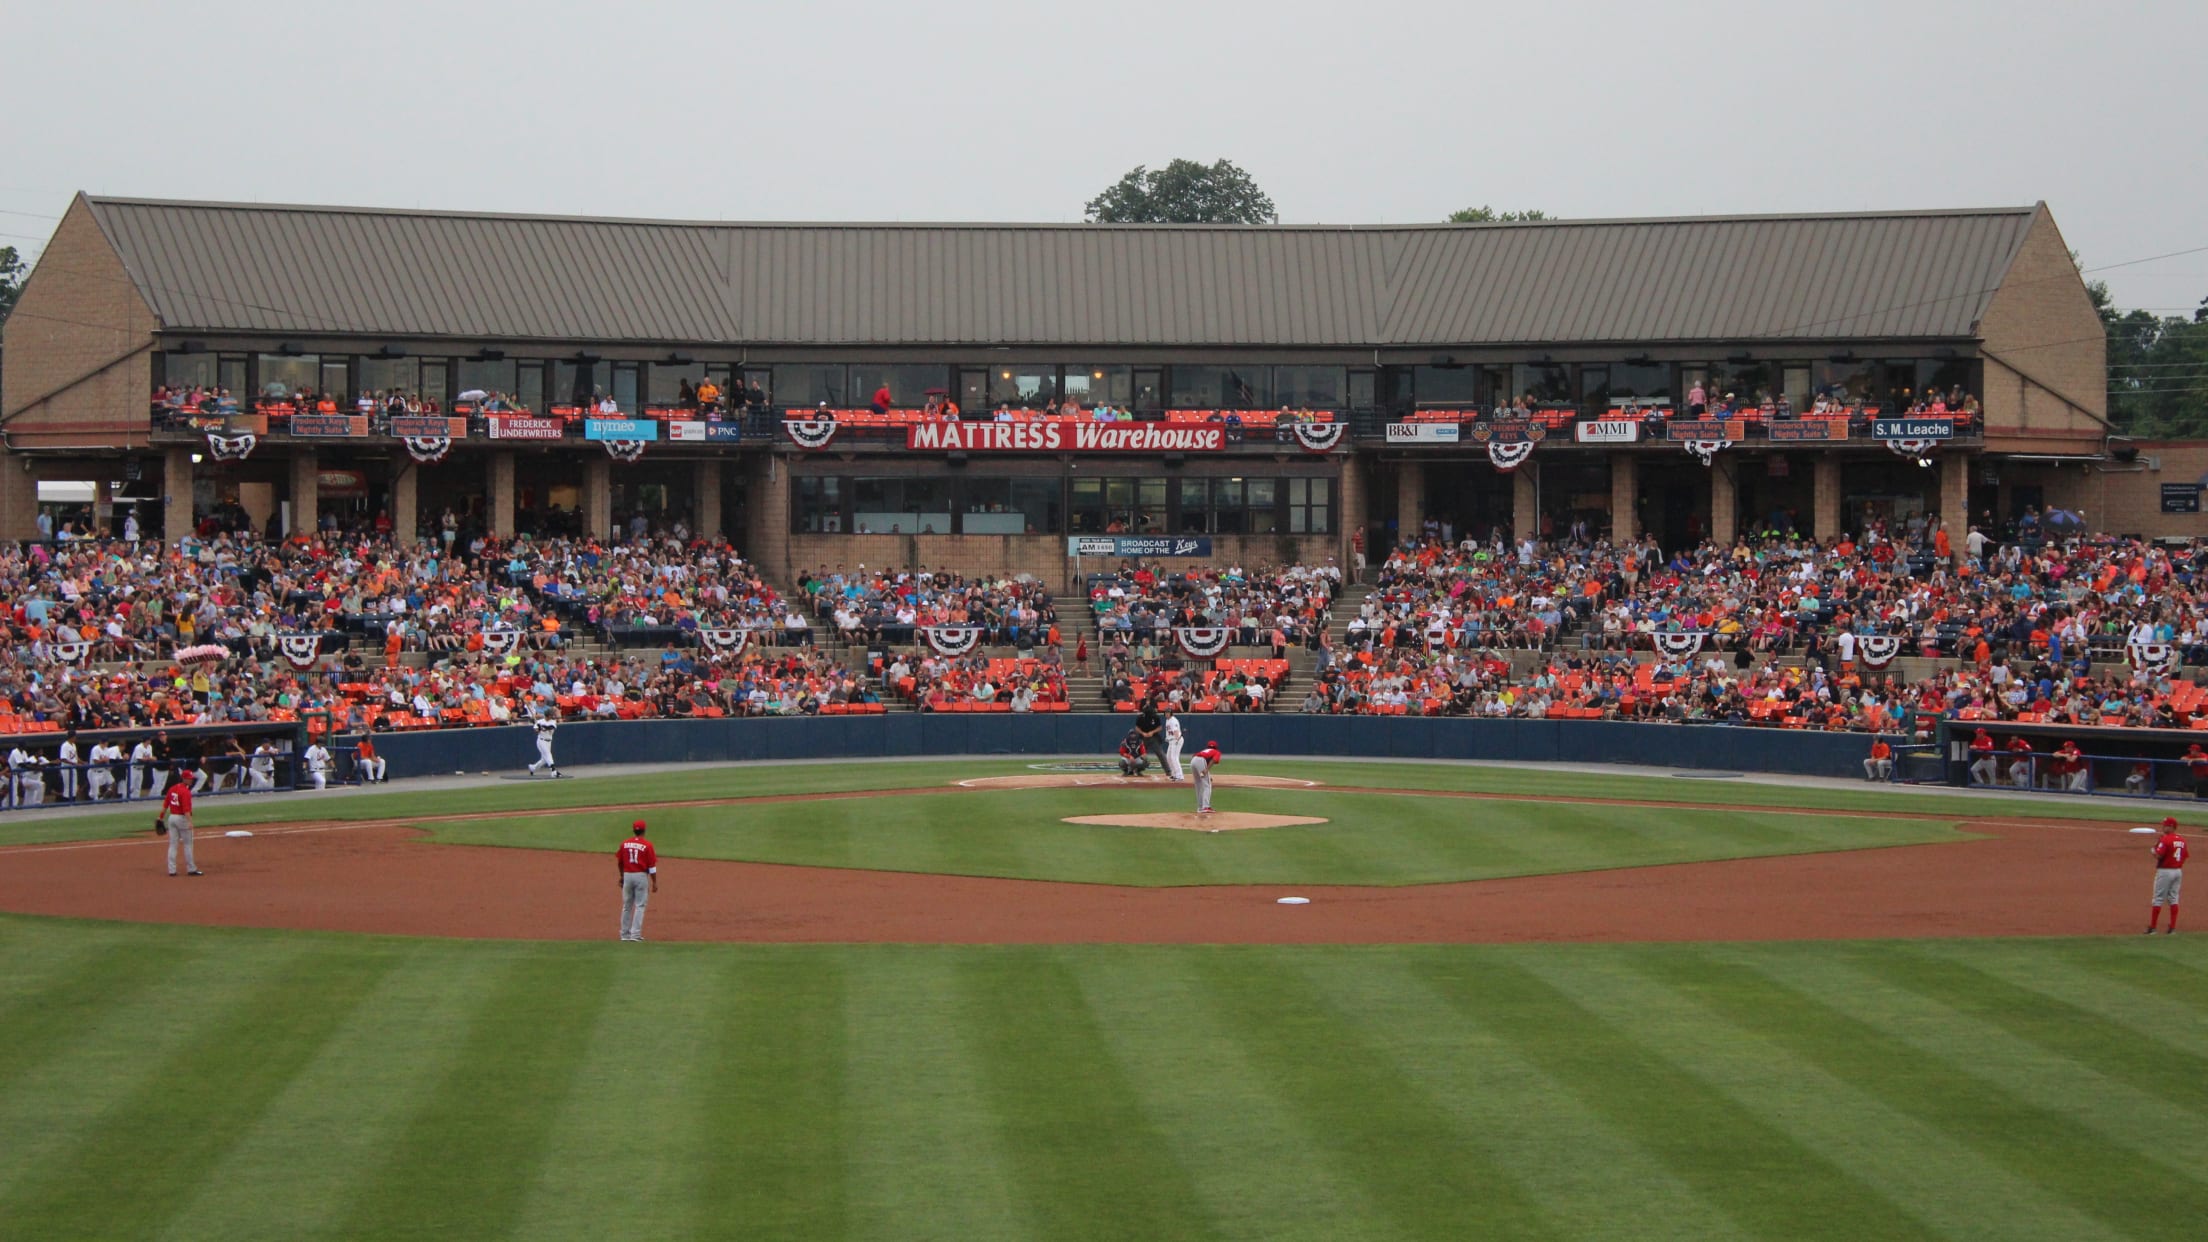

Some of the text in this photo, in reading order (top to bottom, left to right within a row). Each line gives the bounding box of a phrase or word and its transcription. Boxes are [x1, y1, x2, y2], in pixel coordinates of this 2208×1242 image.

[509, 420, 552, 428] FREDERICK
[592, 421, 636, 435] nymeo
[1597, 423, 1628, 434] MMI
[1876, 423, 1949, 435] S. M. Leache
[500, 429, 562, 438] UNDERWRITERS
[718, 427, 737, 435] PNC
[914, 422, 1220, 449] MATTRESS Warehouse
[1388, 425, 1420, 436] BB&T
[1175, 539, 1199, 554] Keys
[629, 848, 638, 864] 11
